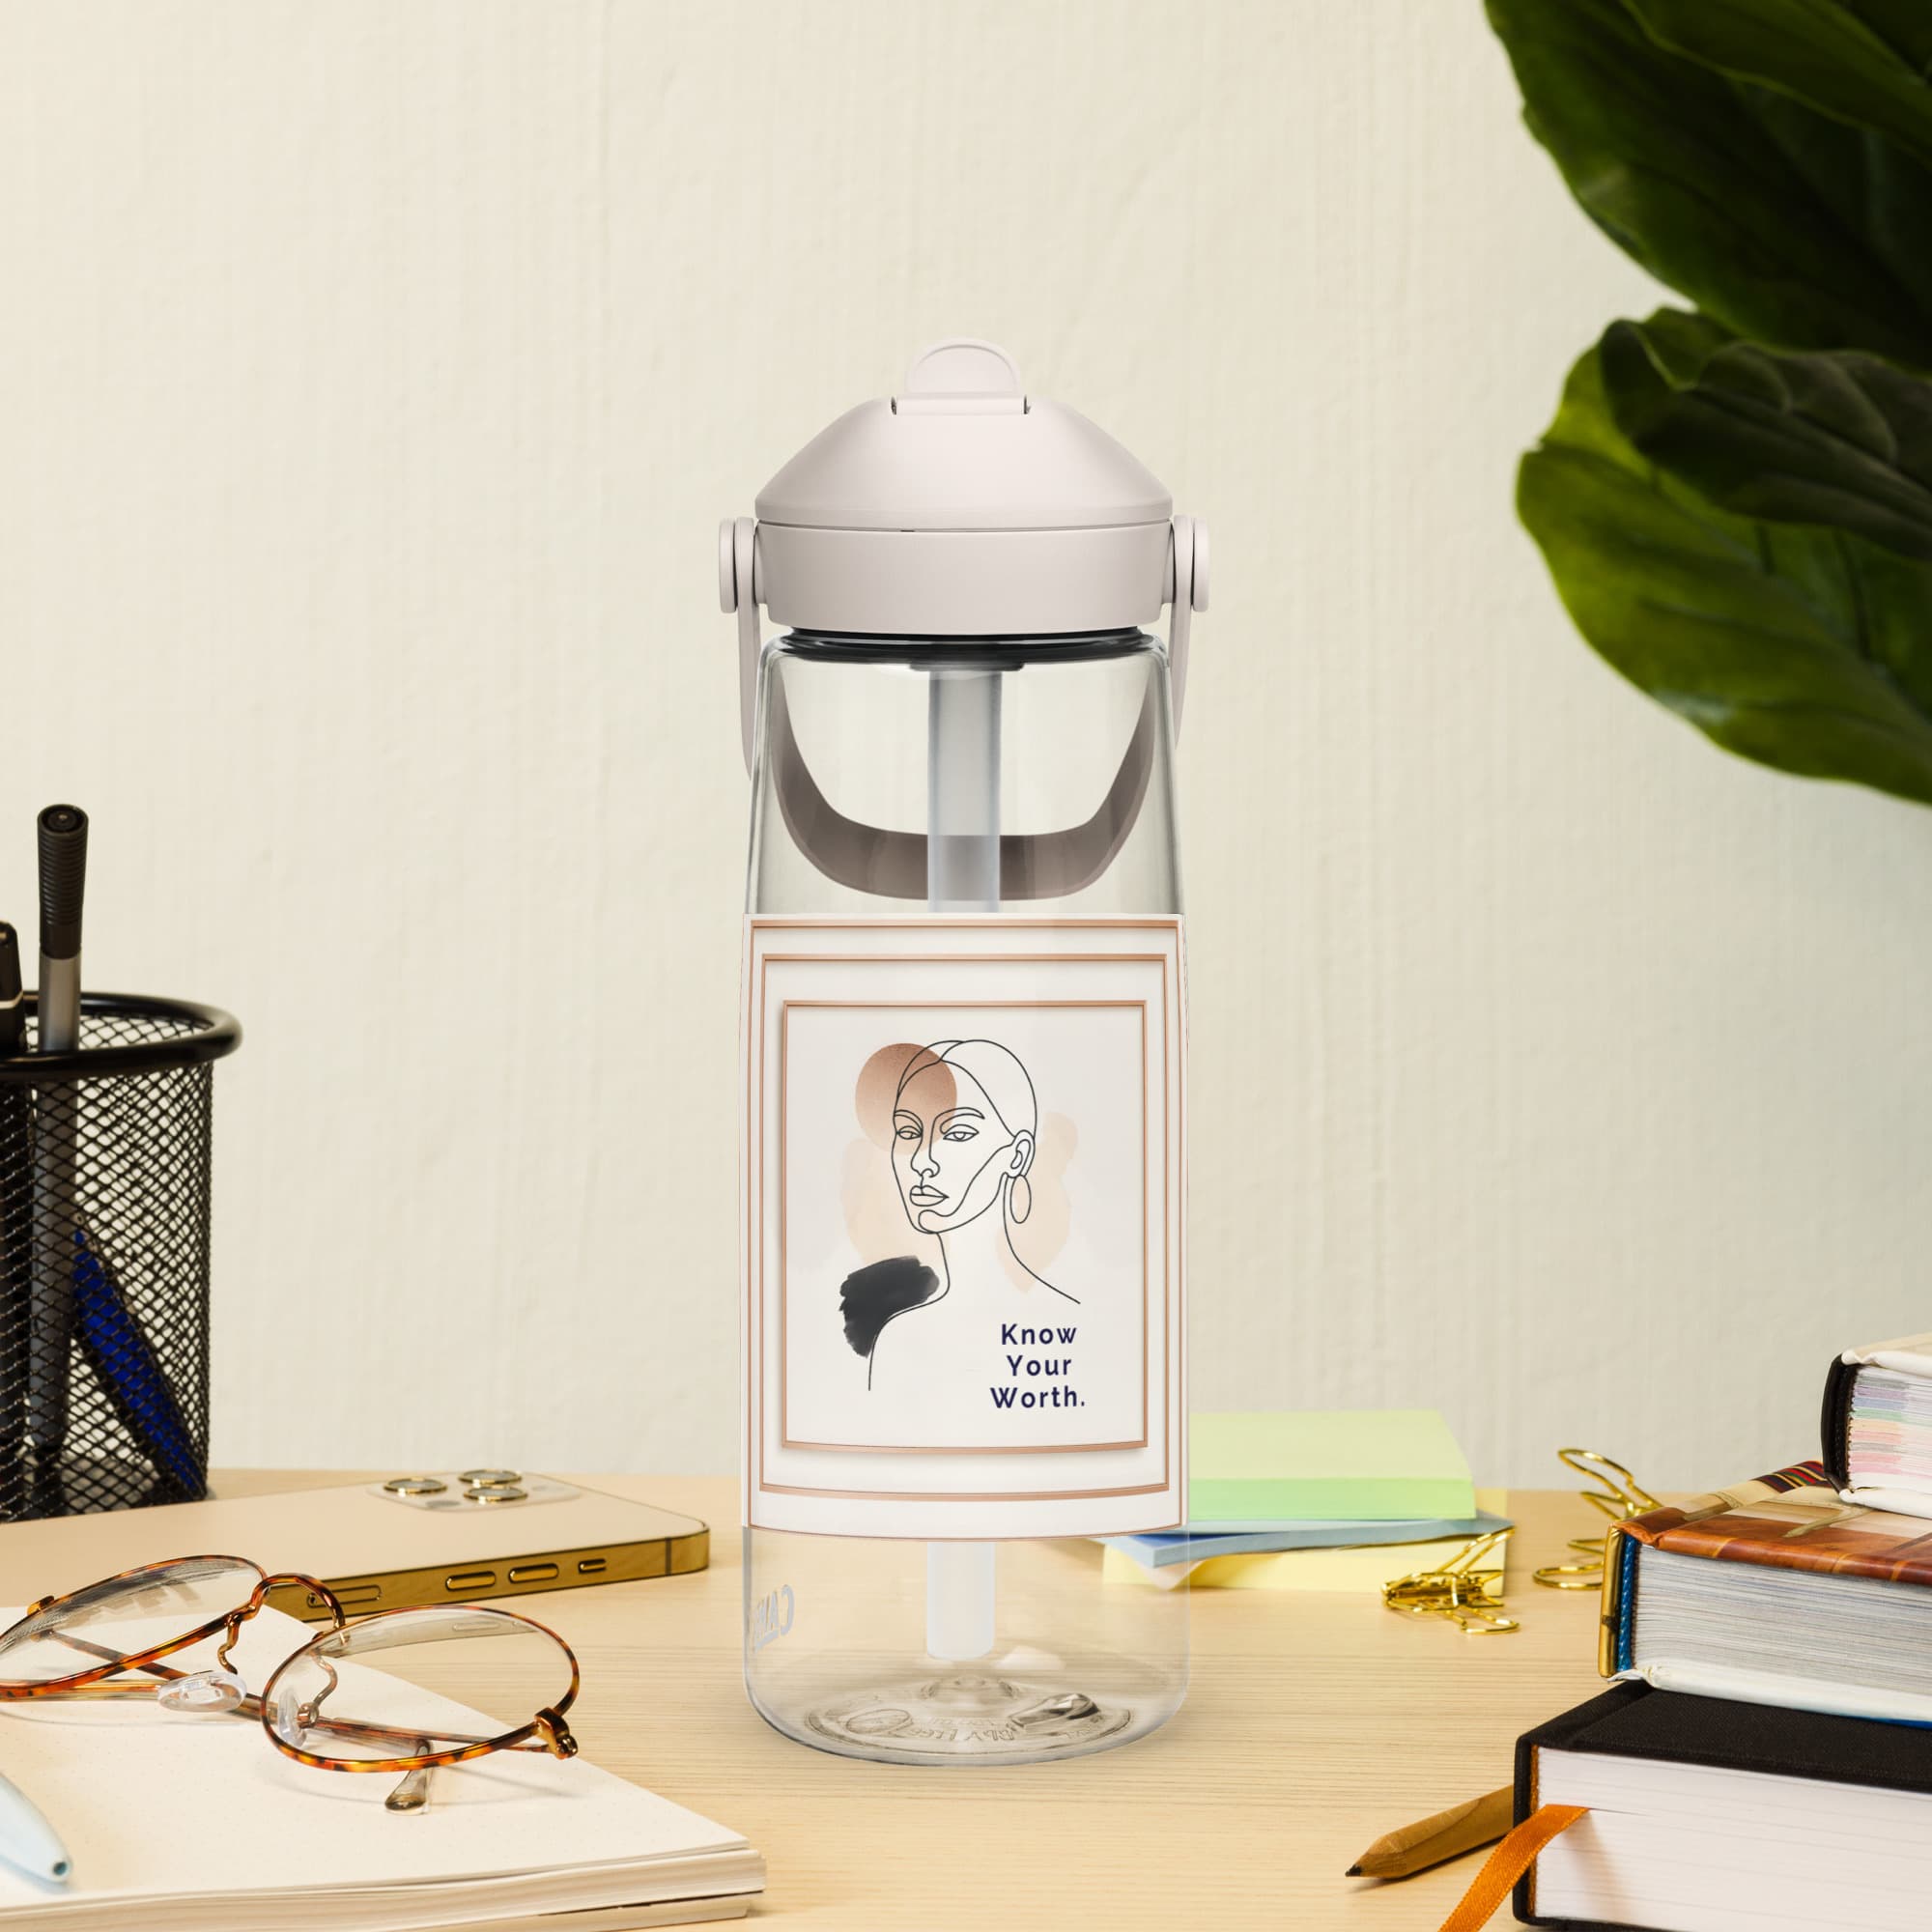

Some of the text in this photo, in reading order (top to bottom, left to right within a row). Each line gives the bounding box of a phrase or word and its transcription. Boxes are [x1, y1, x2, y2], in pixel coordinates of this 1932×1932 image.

[1001, 1322, 1077, 1346] Know
[1006, 1354, 1072, 1377] Your
[989, 1384, 1085, 1409] Worth.
